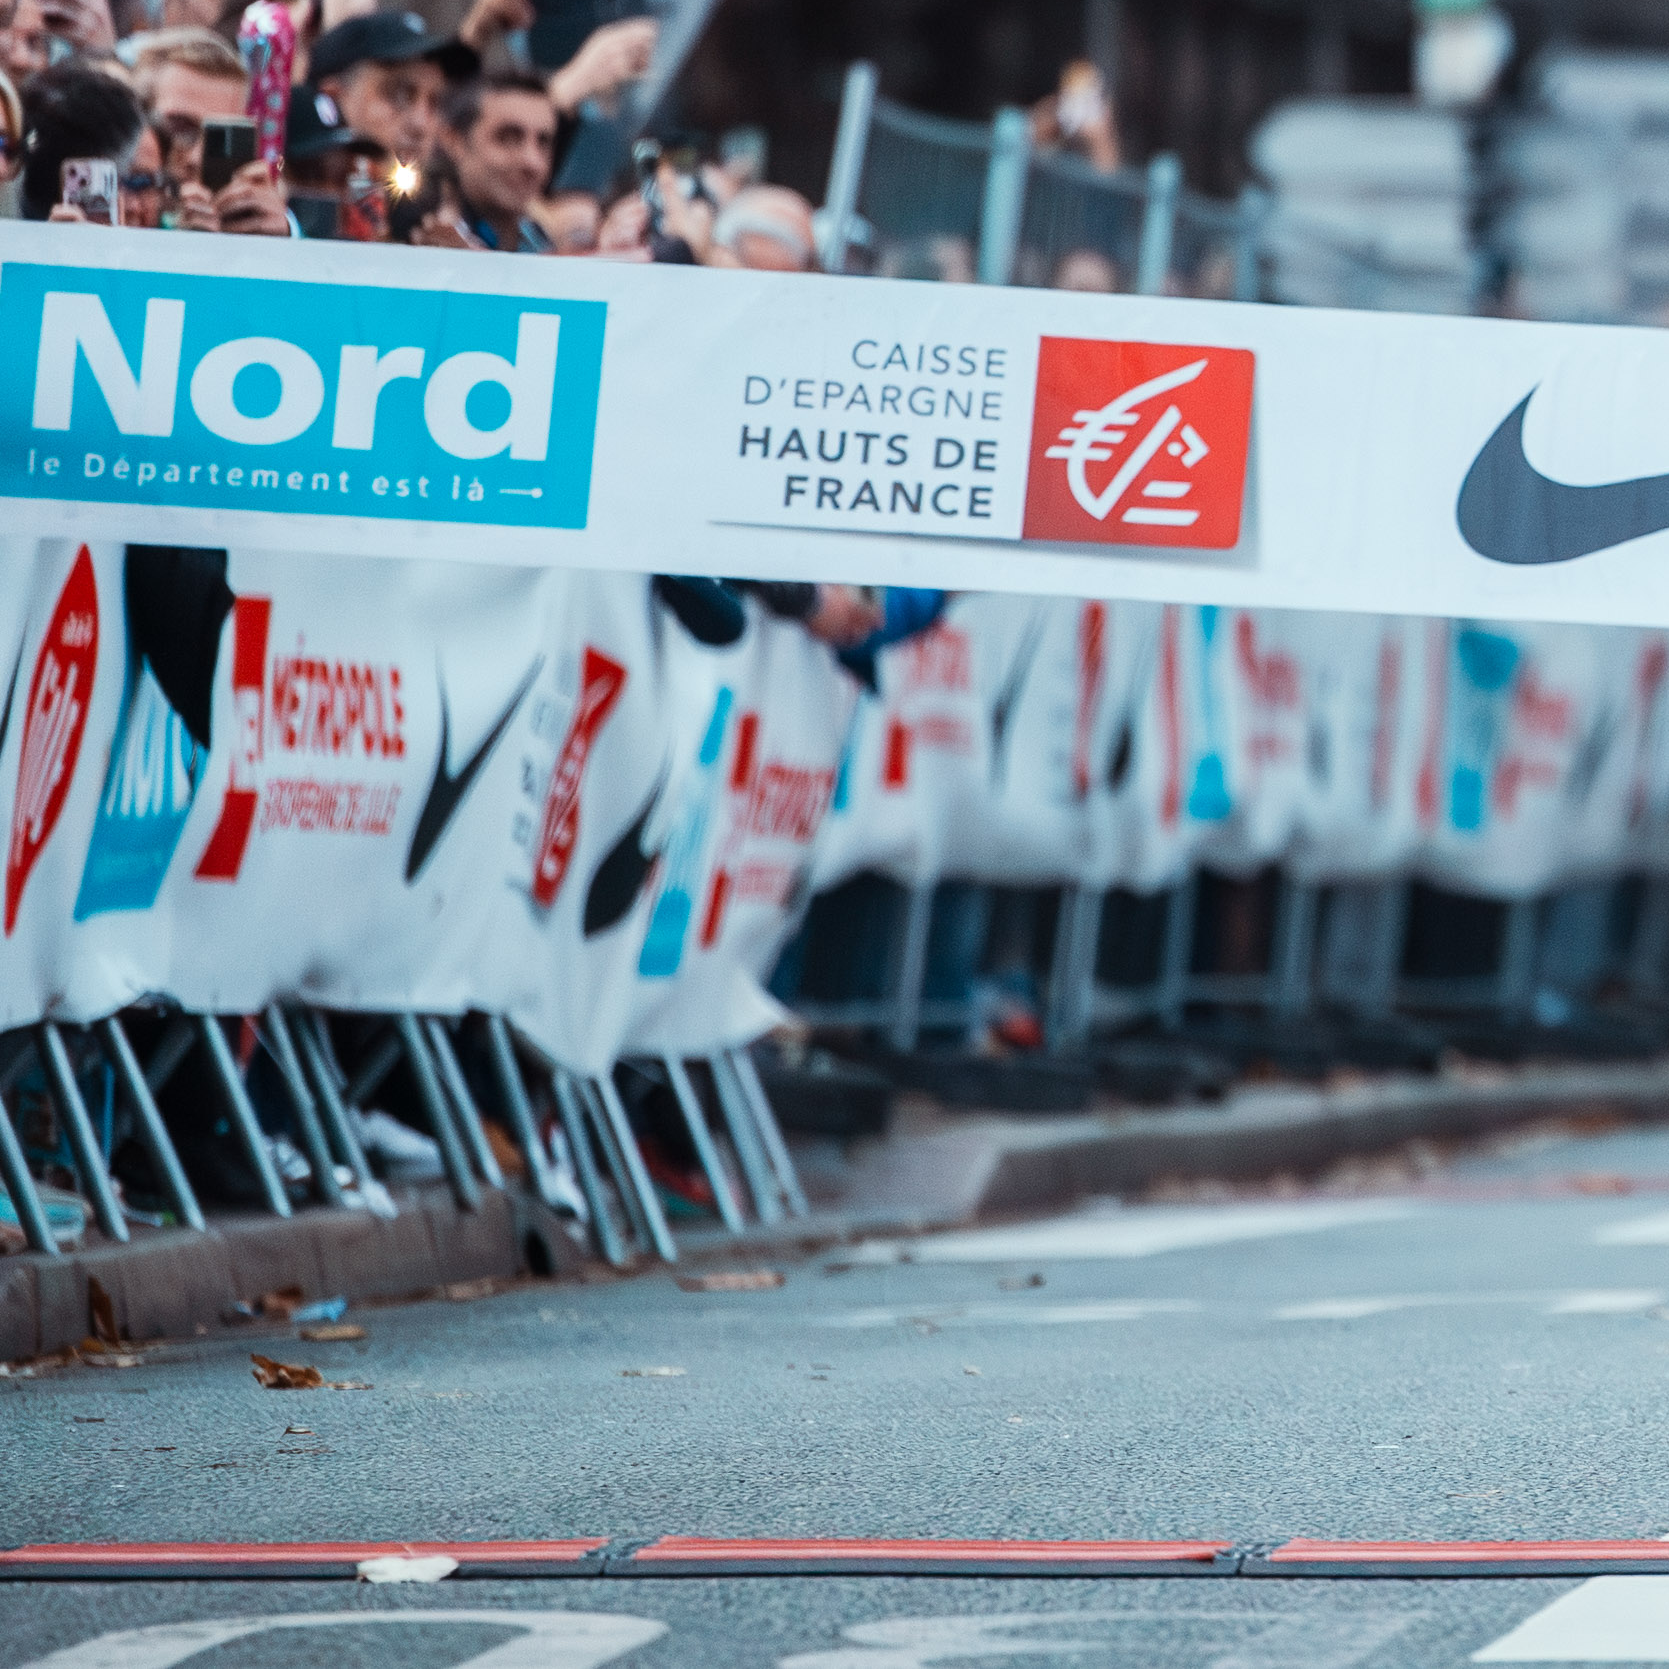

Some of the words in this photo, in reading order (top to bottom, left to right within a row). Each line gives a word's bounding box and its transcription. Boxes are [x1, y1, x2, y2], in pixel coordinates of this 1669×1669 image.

[31, 290, 562, 462] Nord
[851, 339, 1006, 379] CAISSE
[743, 375, 1004, 422] D'EPARGNE
[739, 425, 908, 467] HAUTS
[933, 437, 998, 472] DE
[28, 448, 60, 476] le
[84, 451, 350, 494] Département
[371, 474, 430, 499] est
[451, 475, 485, 502] là
[784, 475, 993, 518] FRANCE
